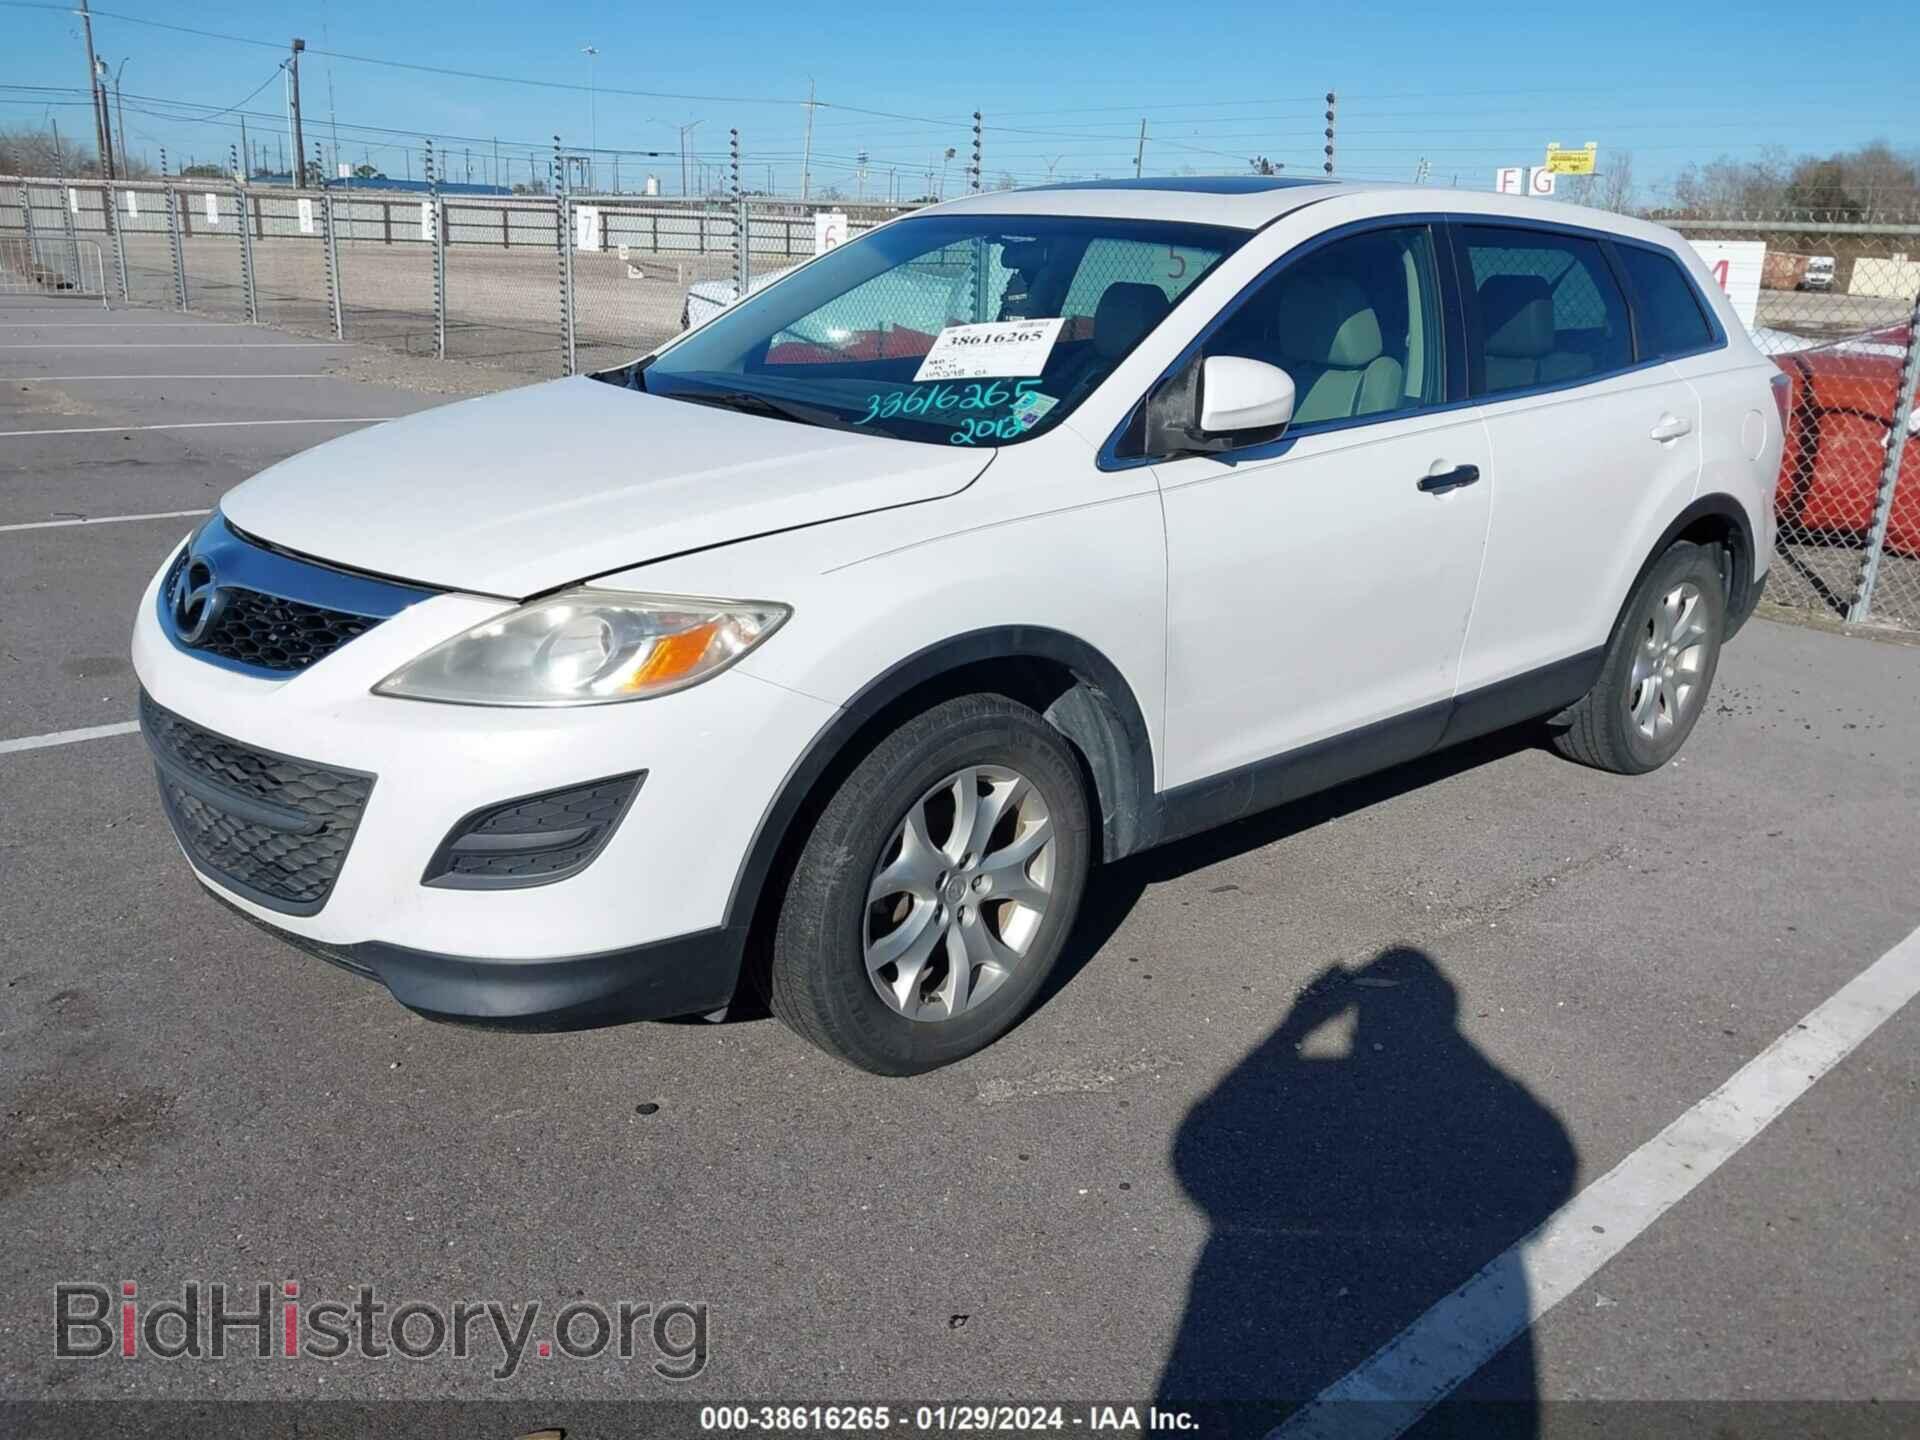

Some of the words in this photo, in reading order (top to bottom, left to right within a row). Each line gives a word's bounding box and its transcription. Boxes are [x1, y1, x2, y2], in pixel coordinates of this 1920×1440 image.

[1534, 168, 1552, 193] G
[583, 215, 592, 241] 7
[824, 225, 838, 250] 6
[947, 330, 1044, 347] 38616265
[950, 415, 1027, 445] 2012
